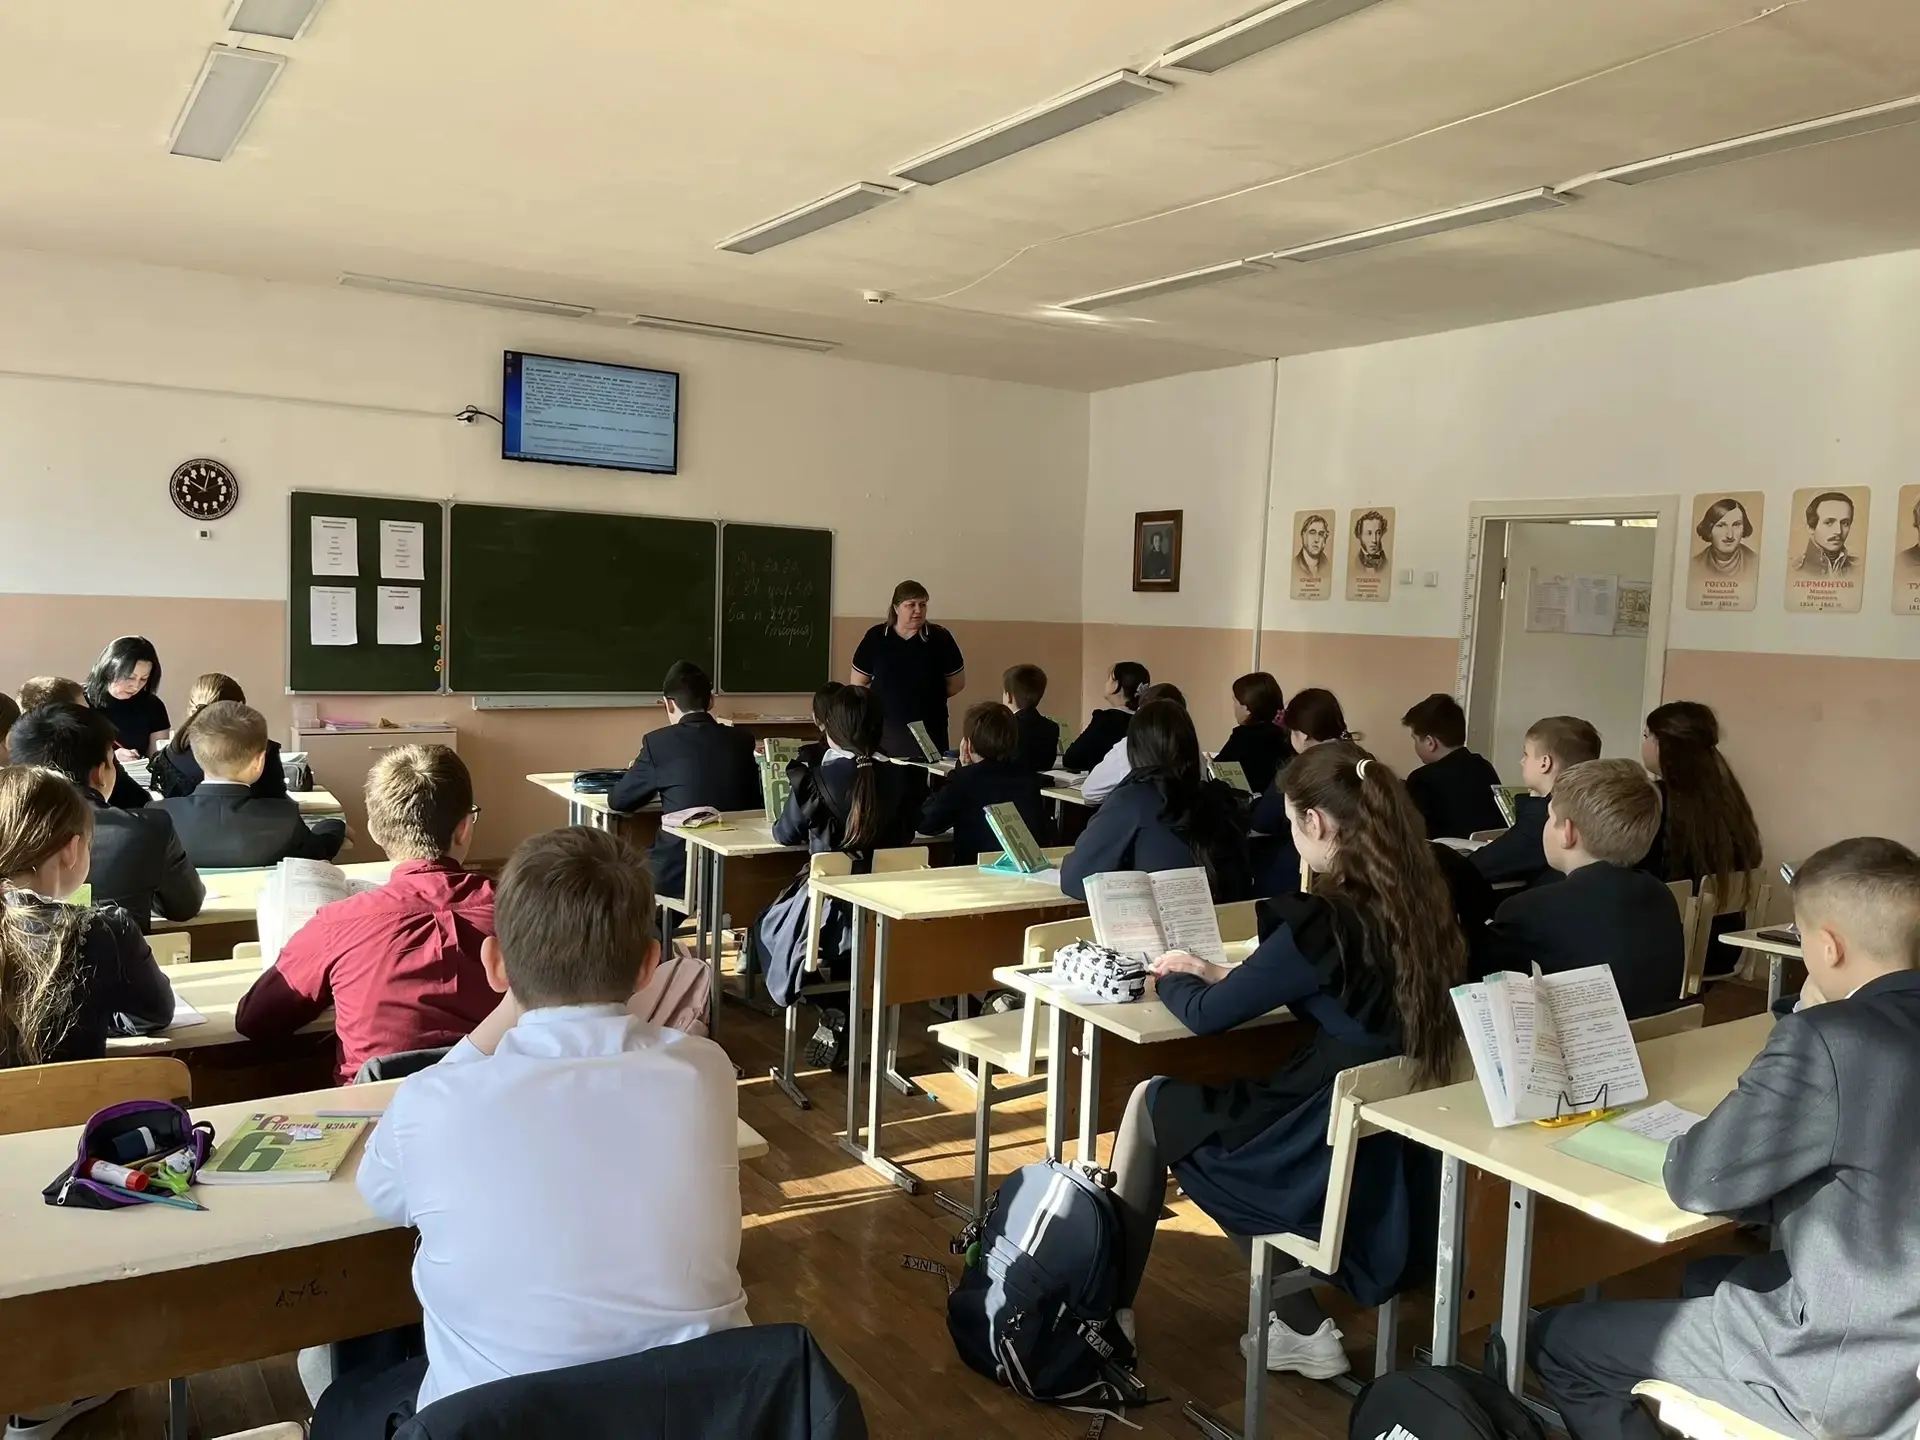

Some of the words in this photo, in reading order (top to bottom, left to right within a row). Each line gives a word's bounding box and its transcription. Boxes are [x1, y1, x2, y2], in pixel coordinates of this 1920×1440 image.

[1704, 580, 1738, 588] ГОГОЛЬ
[1793, 580, 1855, 588] ЛЕРМОНТОВ
[325, 1122, 358, 1130] язык
[216, 1131, 295, 1172] 6
